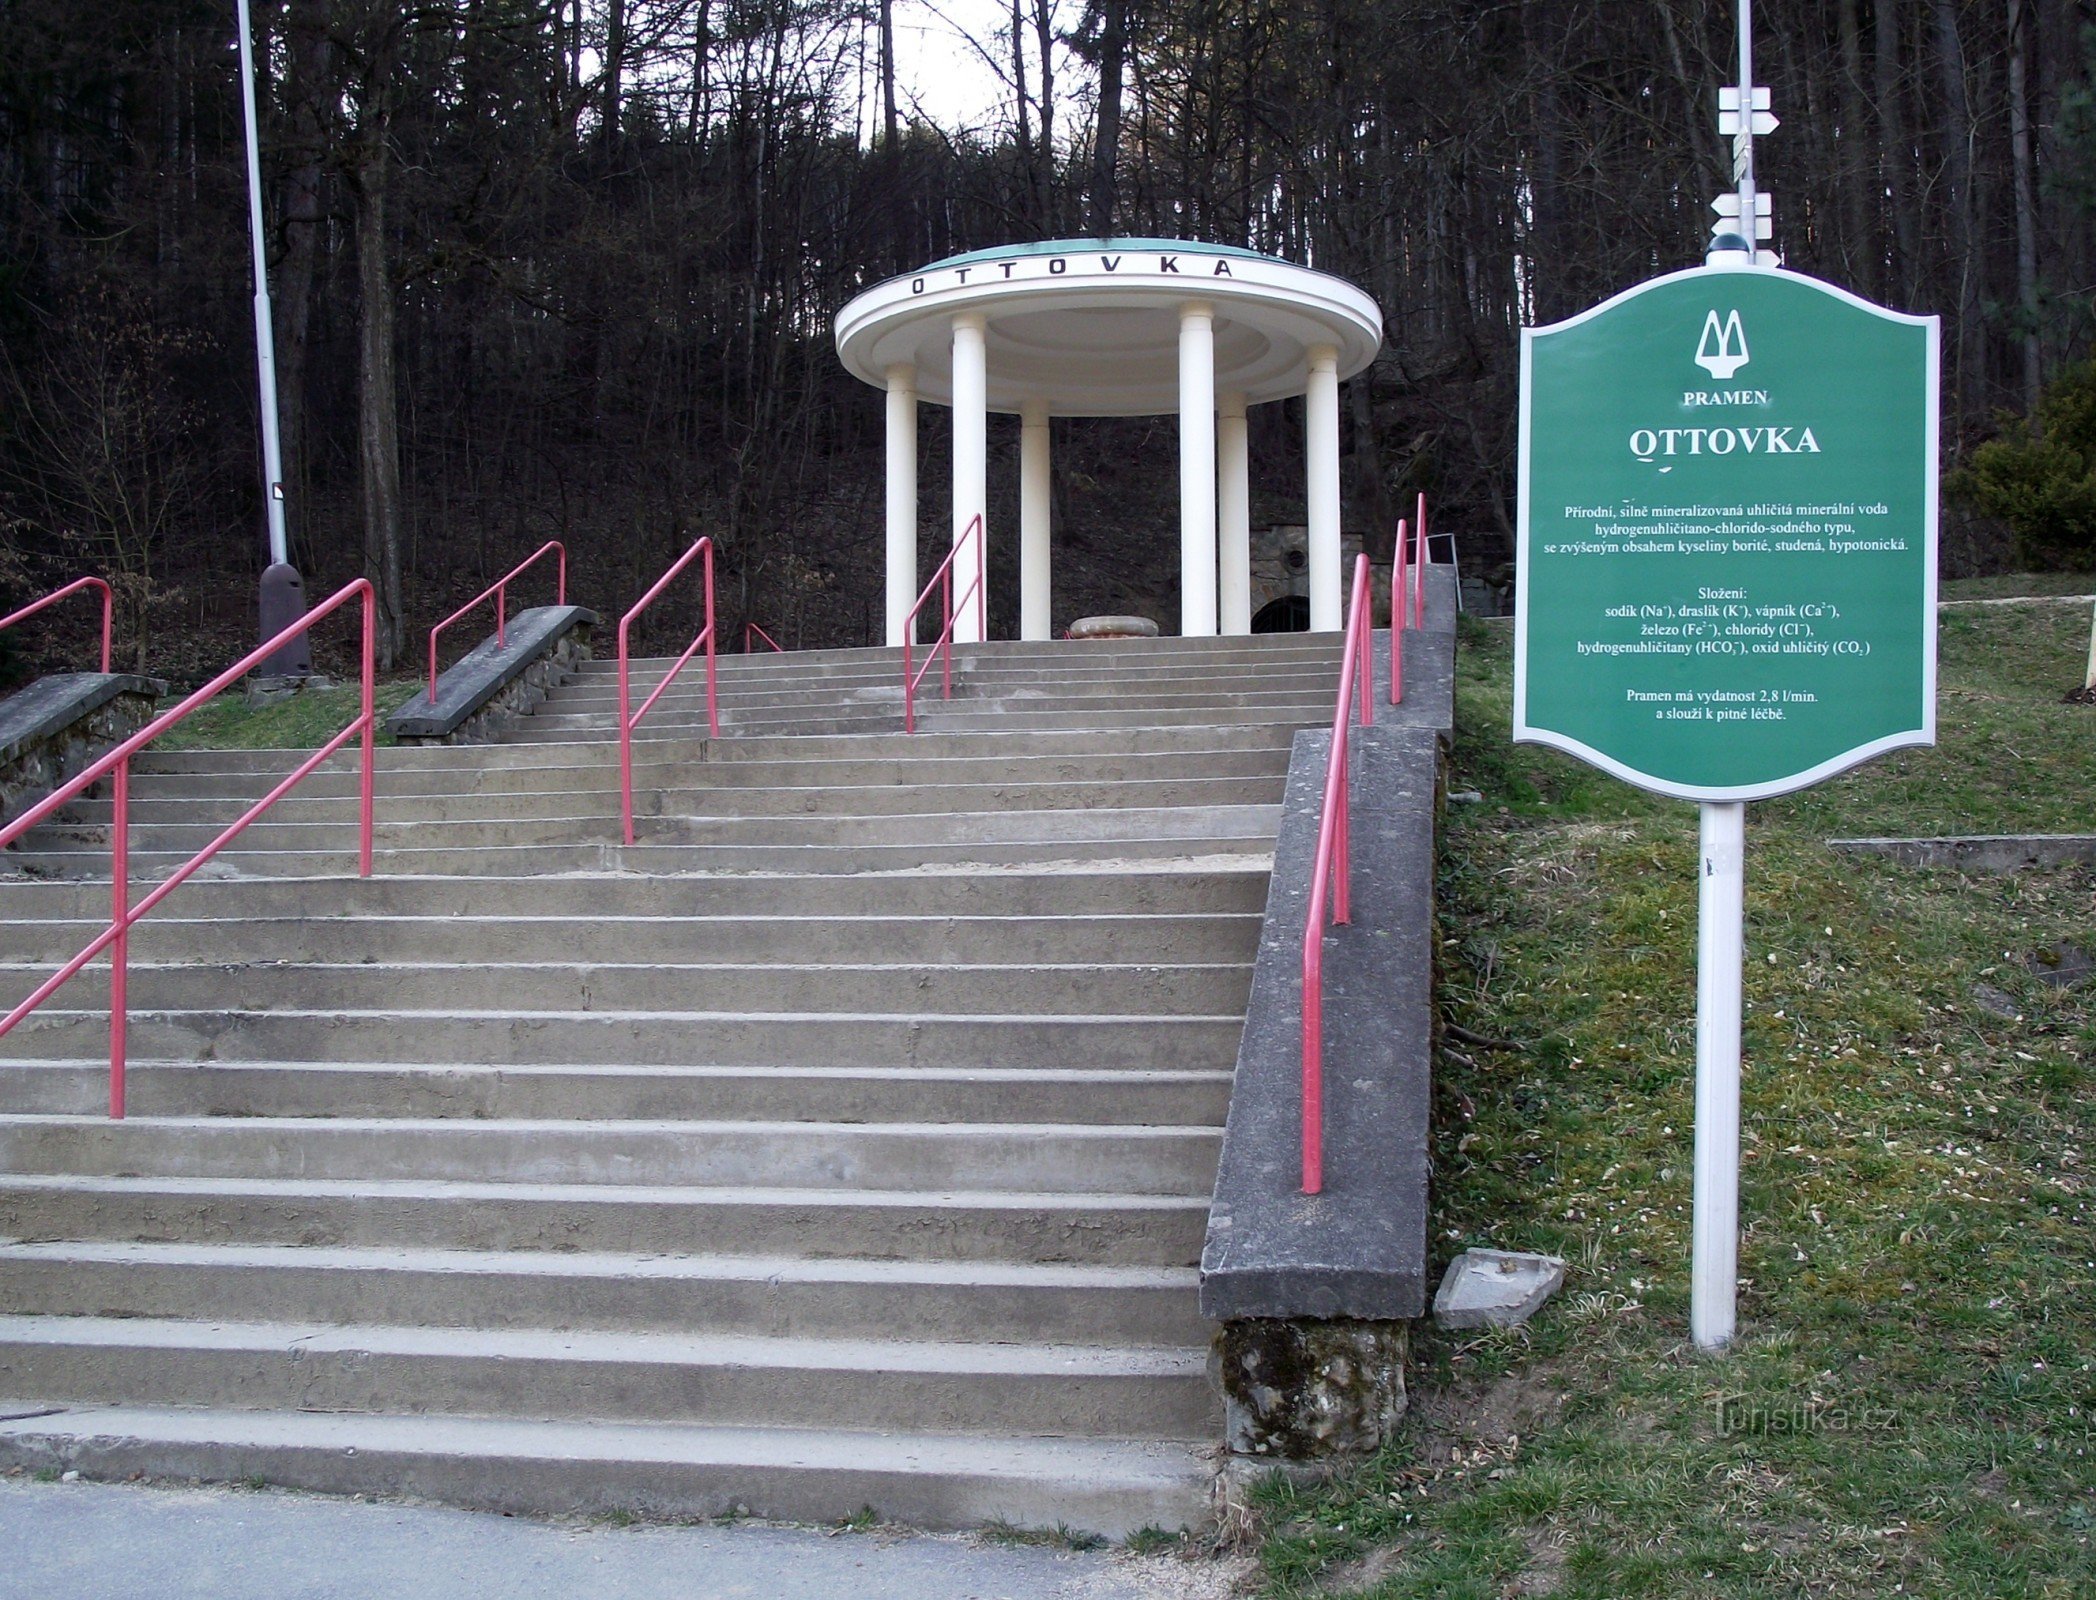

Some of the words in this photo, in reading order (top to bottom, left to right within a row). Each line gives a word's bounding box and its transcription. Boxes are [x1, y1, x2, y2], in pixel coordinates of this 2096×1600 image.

[911, 255, 1232, 294] OTTOVKA
[1683, 389, 1767, 406] PRAMEN
[1629, 427, 1821, 456] OTTOVKA
[1564, 505, 1616, 519] Přírodní,
[1620, 505, 1648, 517] silně
[1651, 504, 1743, 517] mineralizovaná
[1747, 503, 1793, 516] uhličitá
[1796, 503, 1854, 516] minerální
[1858, 502, 1888, 515] voda
[1595, 521, 1821, 538] hydrogenuhličitano-chlorido-sodného
[1824, 523, 1855, 536] typu,
[1543, 545, 1556, 554] se
[1560, 541, 1619, 556] zvýšeným
[1622, 540, 1675, 553] obsahem
[1678, 540, 1729, 555] kyseliny
[1732, 539, 1771, 553] borité,
[1775, 539, 1825, 553] studená,
[1829, 538, 1909, 554] hypotonická.
[1698, 587, 1747, 600] Složení:
[1605, 605, 1637, 617] sodík
[1678, 604, 1719, 617] draslík
[1755, 604, 1796, 619] vápník
[1641, 623, 1680, 636] železo
[1725, 623, 1776, 638] chloridy
[1577, 641, 1692, 656] hydrogenuhličitany
[1752, 641, 1779, 653] oxid
[1783, 640, 1829, 656] uhličitý
[1626, 689, 1672, 702] Pramen
[1675, 689, 1693, 702] má
[1697, 690, 1755, 705] vydatnost
[1759, 690, 1779, 703] 2,8
[1782, 690, 1818, 702] l/min.
[1655, 711, 1663, 719] a
[1666, 707, 1702, 720] slouží
[1706, 708, 1713, 719] k
[1716, 708, 1747, 722] pitné
[1751, 708, 1787, 720] léčbě.
